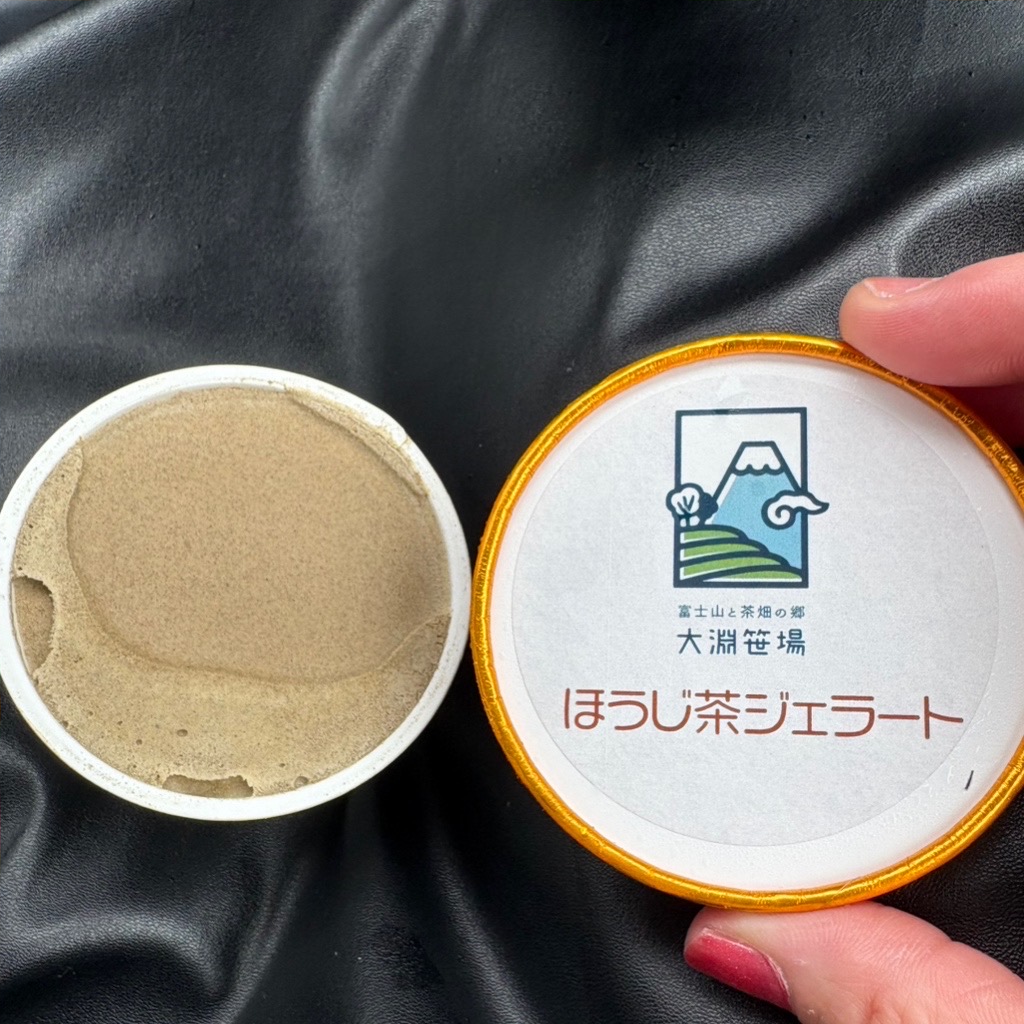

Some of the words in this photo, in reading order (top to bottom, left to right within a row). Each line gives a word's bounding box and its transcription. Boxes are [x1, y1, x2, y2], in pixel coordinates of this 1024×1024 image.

[678, 604, 806, 619] 富士山と茶畑の郷
[676, 628, 807, 657] 大淵笹場
[562, 687, 966, 739] ほうじ茶ジェラート
